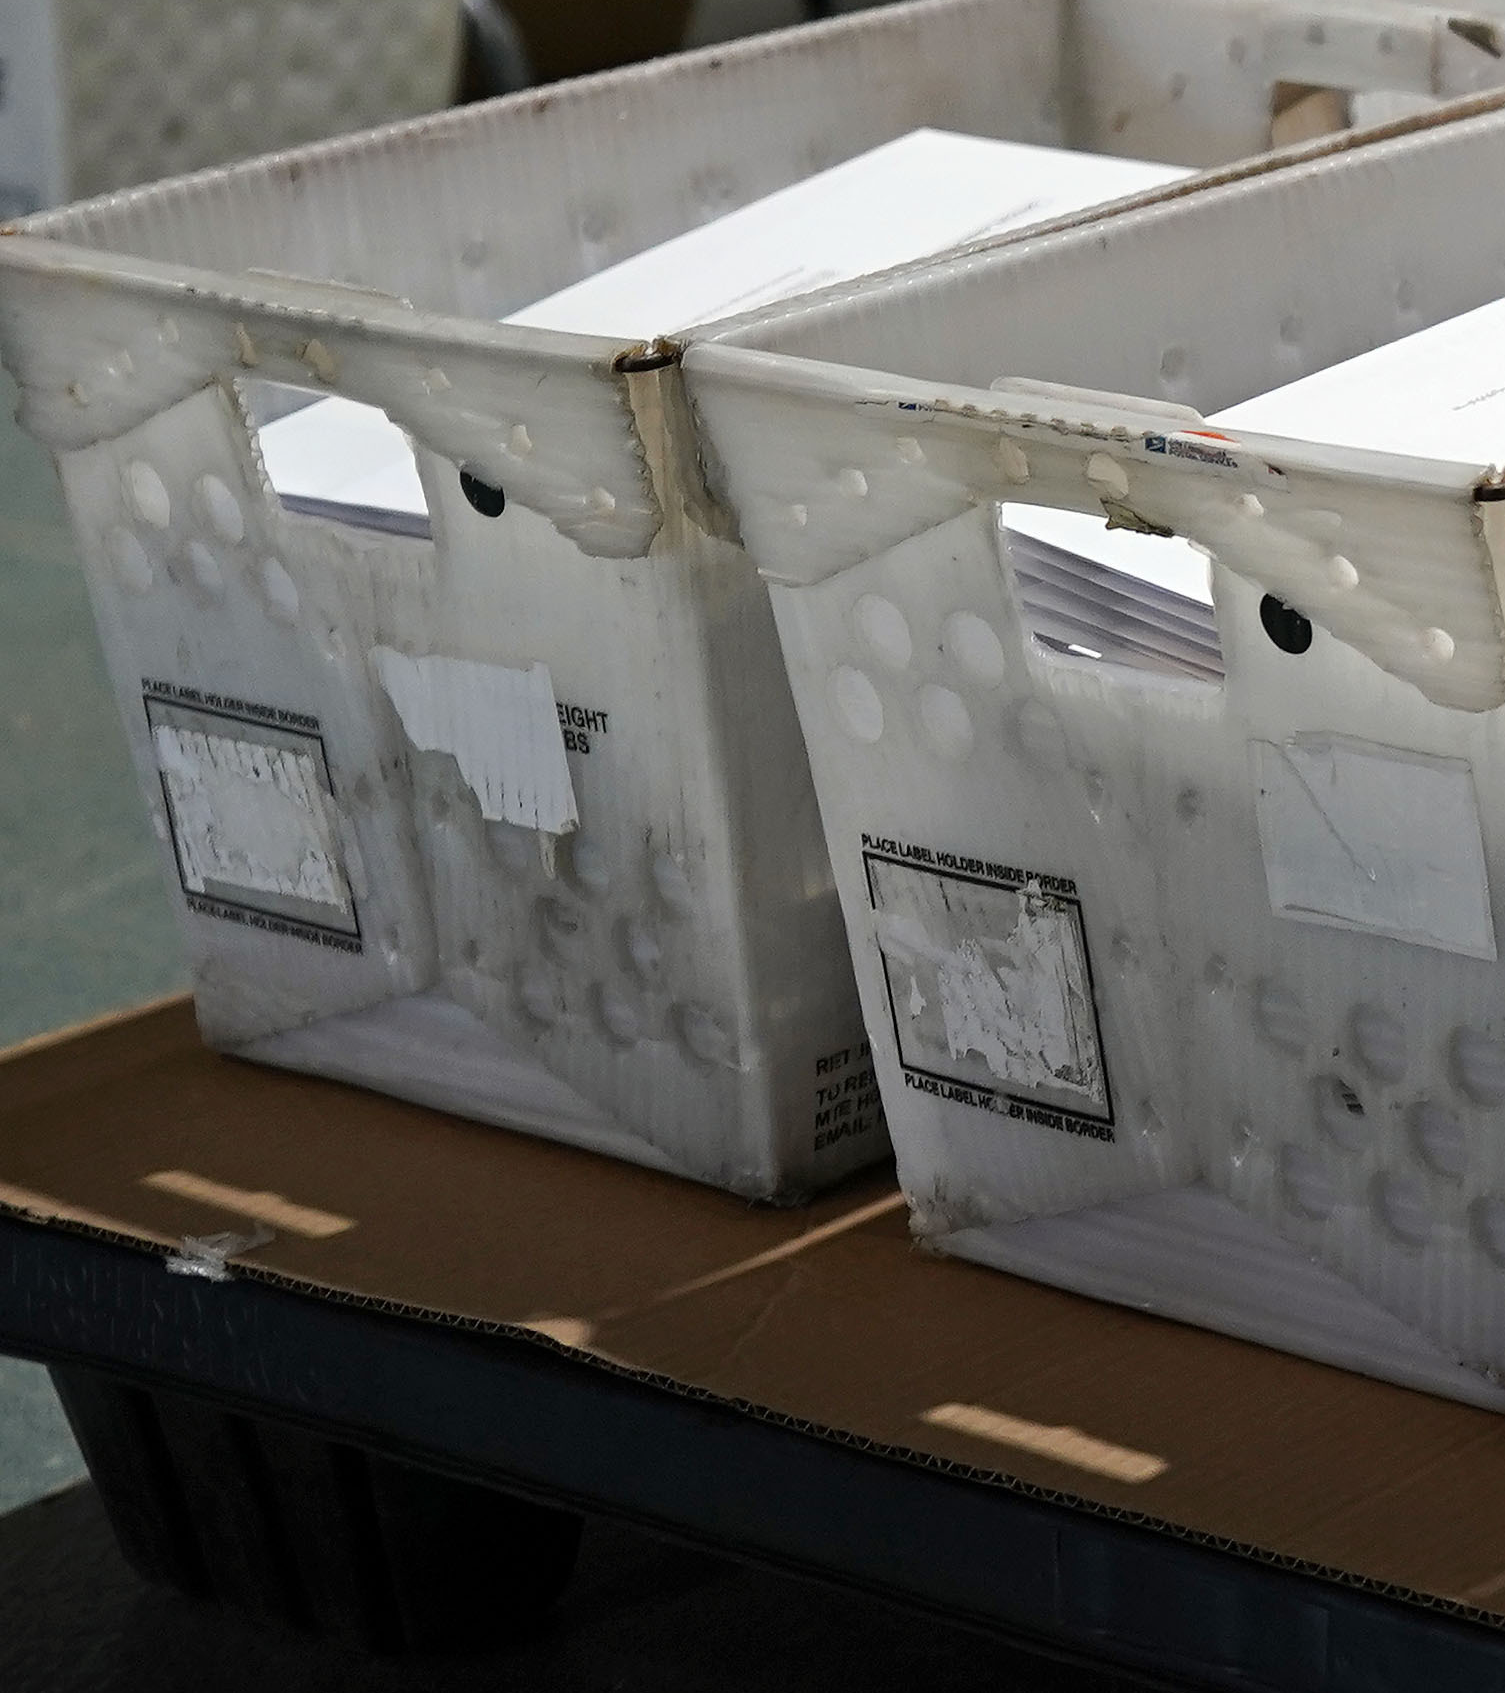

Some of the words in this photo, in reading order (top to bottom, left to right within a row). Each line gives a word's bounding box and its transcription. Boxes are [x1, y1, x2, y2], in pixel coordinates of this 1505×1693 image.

[556, 702, 608, 733] EIGHT
[563, 729, 590, 754] BS
[861, 833, 897, 855] PLACE
[899, 841, 936, 864] LABEL
[936, 851, 985, 875] HOLDER
[985, 862, 1025, 883] INSIDE
[904, 1073, 940, 1096] PLACE
[941, 1086, 977, 1108] LABEL
[1026, 1105, 1064, 1132] INSIDE
[1065, 1115, 1116, 1144] BORDER
